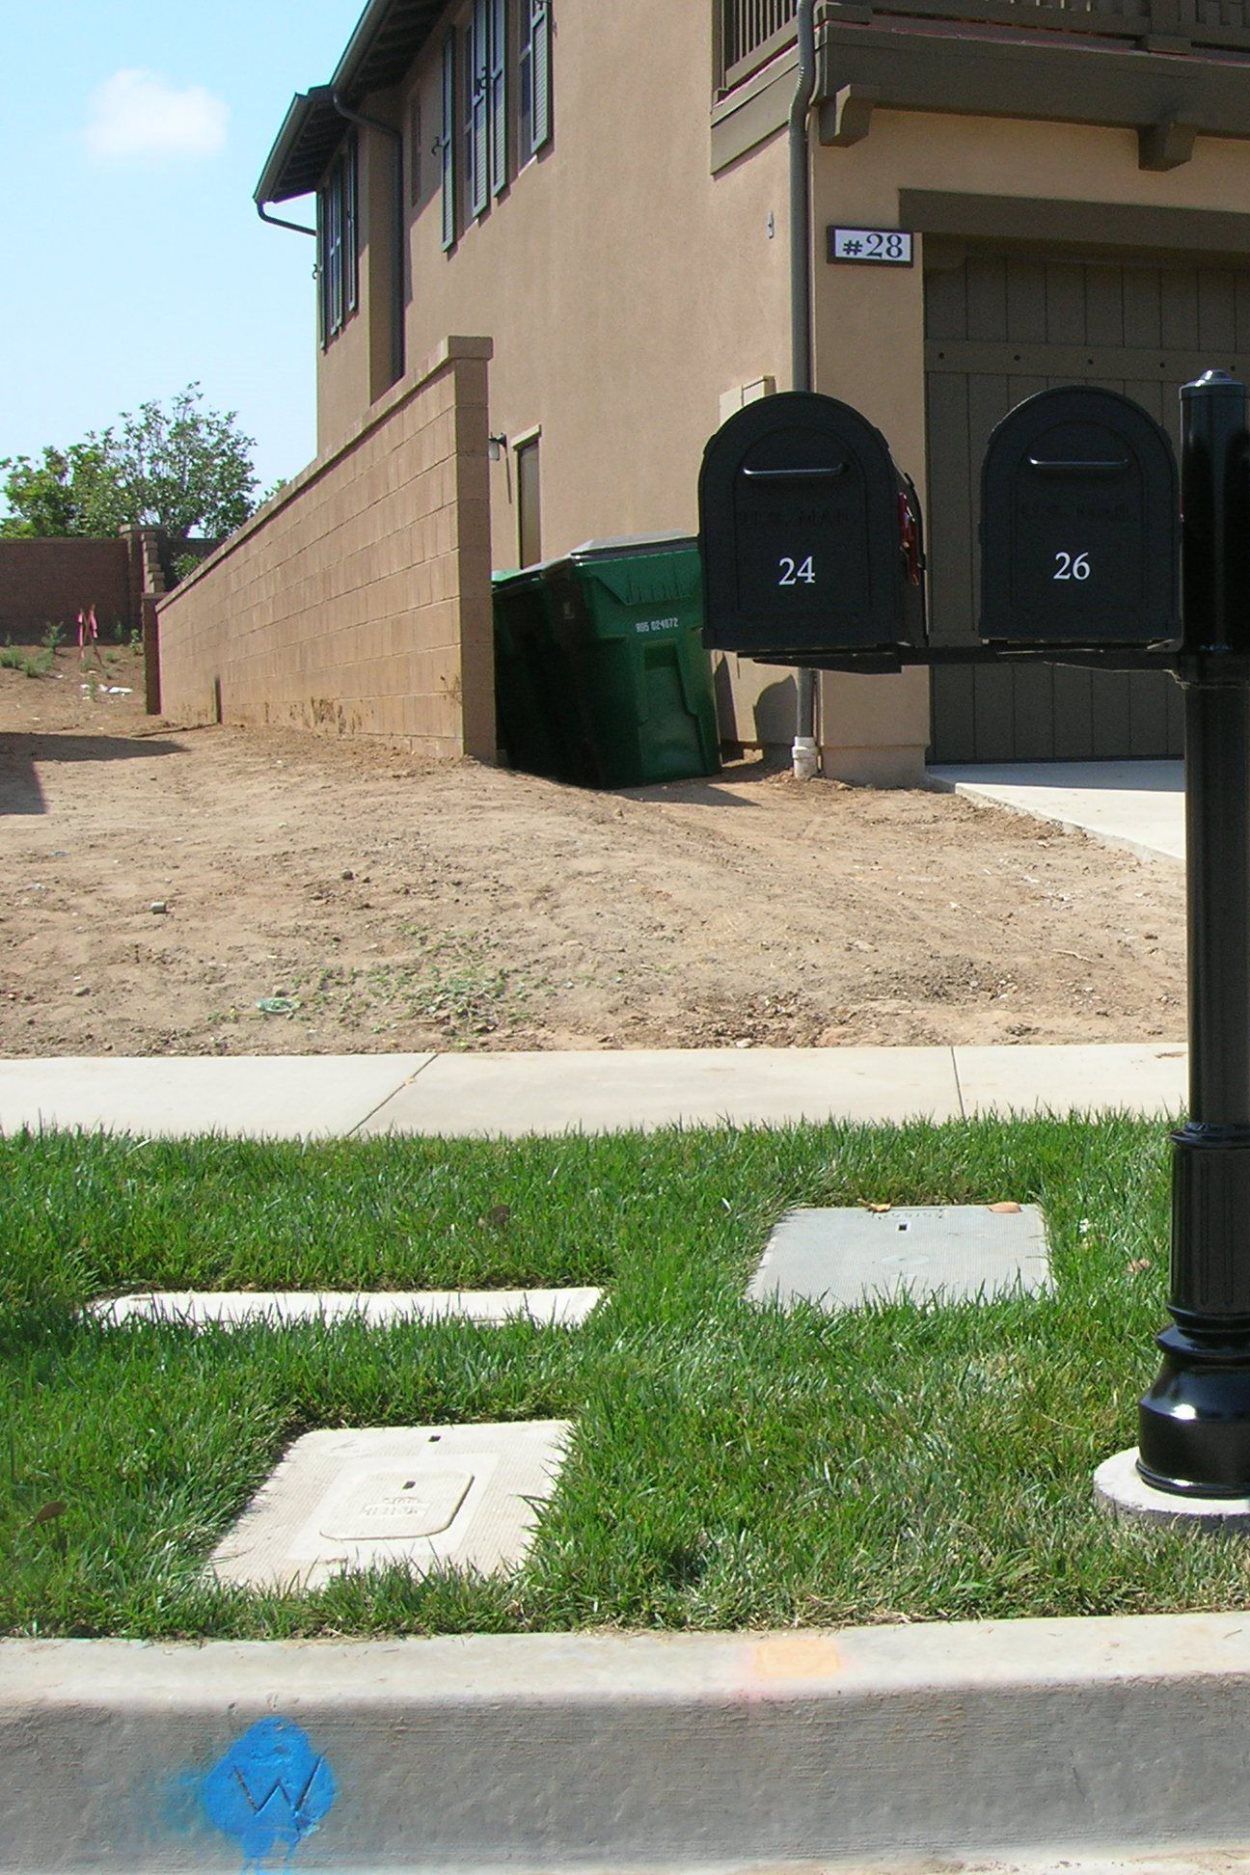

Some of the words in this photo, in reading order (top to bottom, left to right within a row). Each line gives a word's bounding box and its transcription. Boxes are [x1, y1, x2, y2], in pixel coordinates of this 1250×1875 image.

[842, 232, 903, 258] #28
[778, 555, 816, 585] 24
[1053, 551, 1091, 580] 26
[232, 1752, 324, 1813] W
